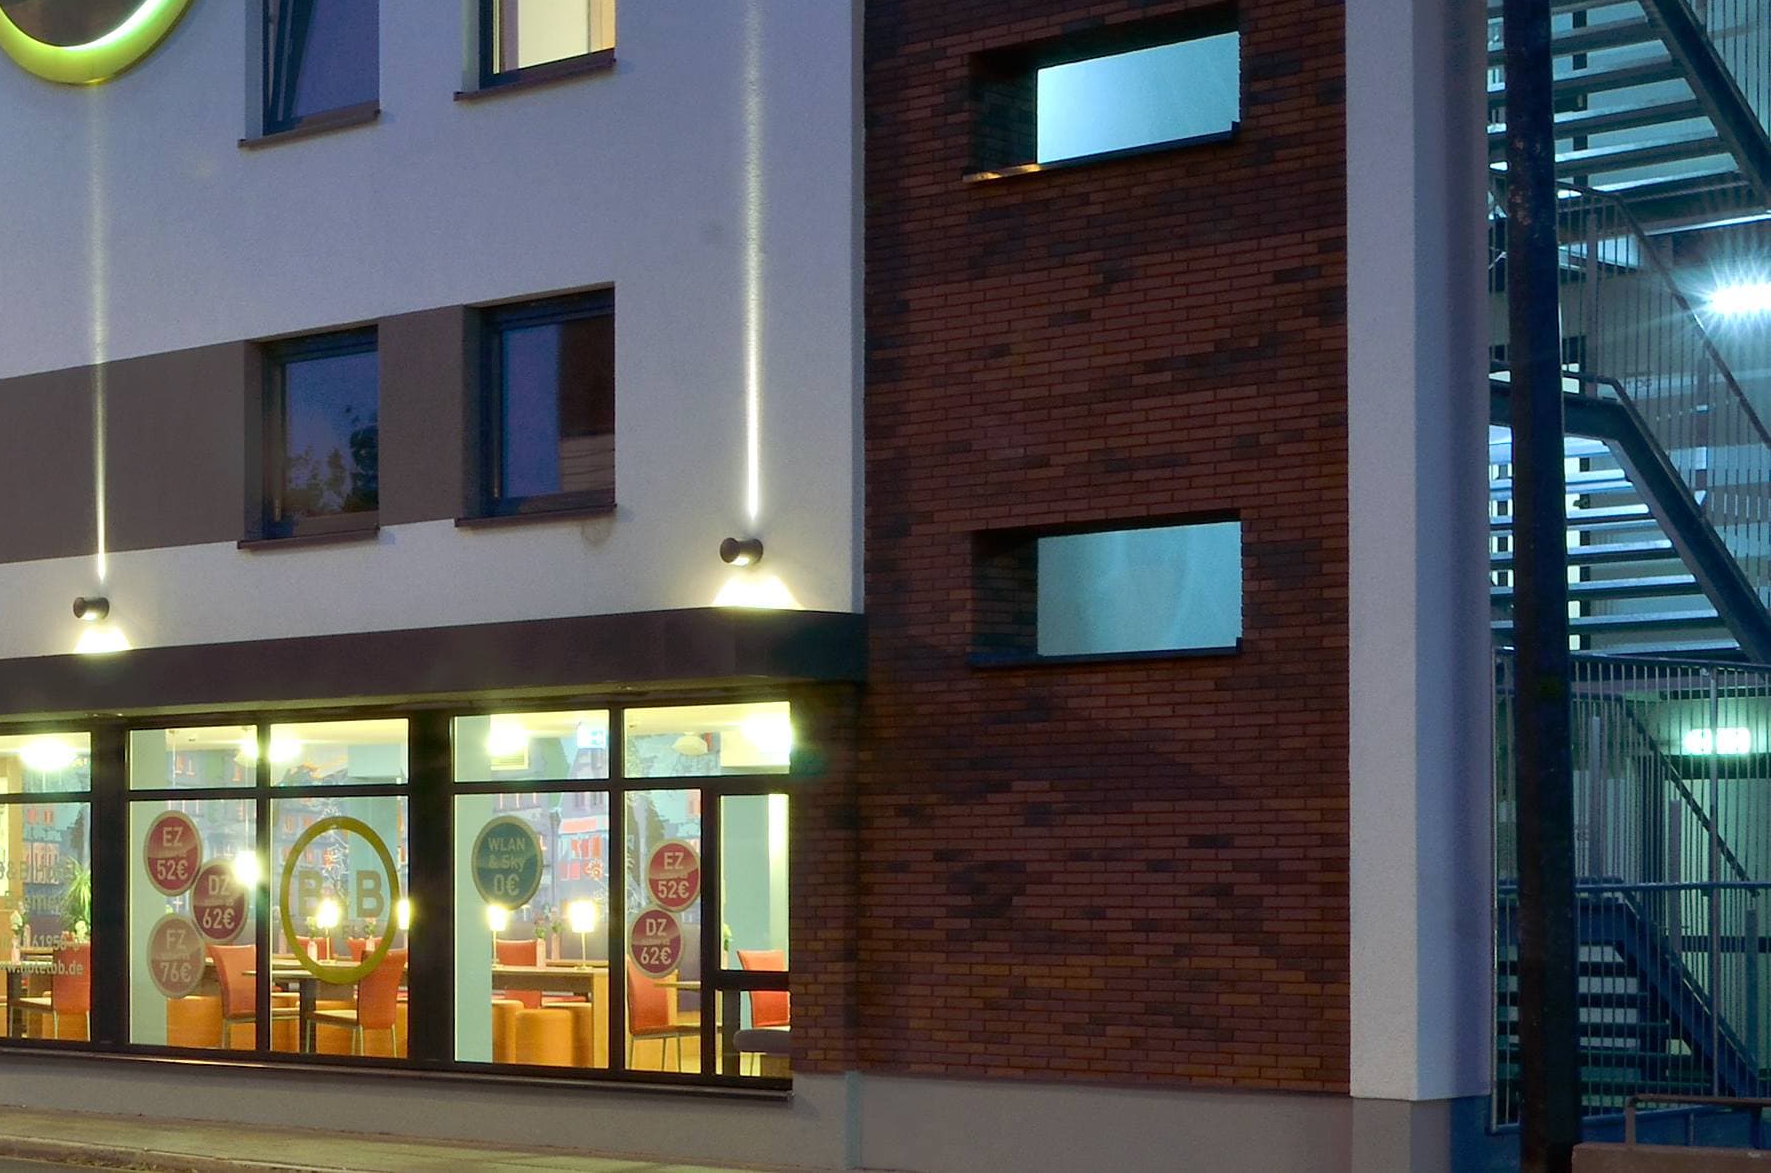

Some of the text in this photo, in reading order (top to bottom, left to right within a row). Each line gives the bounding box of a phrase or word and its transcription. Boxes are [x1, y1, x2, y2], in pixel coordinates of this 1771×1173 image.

[162, 826, 184, 847] EZ
[488, 836, 526, 852] WLAN
[156, 859, 189, 881] 52€
[663, 851, 685, 870] EZ
[208, 874, 231, 896] DZ
[298, 870, 385, 918] BB
[657, 879, 690, 899] 52€
[202, 907, 236, 930] 62€
[645, 918, 668, 937] DZ
[640, 945, 672, 965] 62€
[159, 961, 192, 983] 76€
